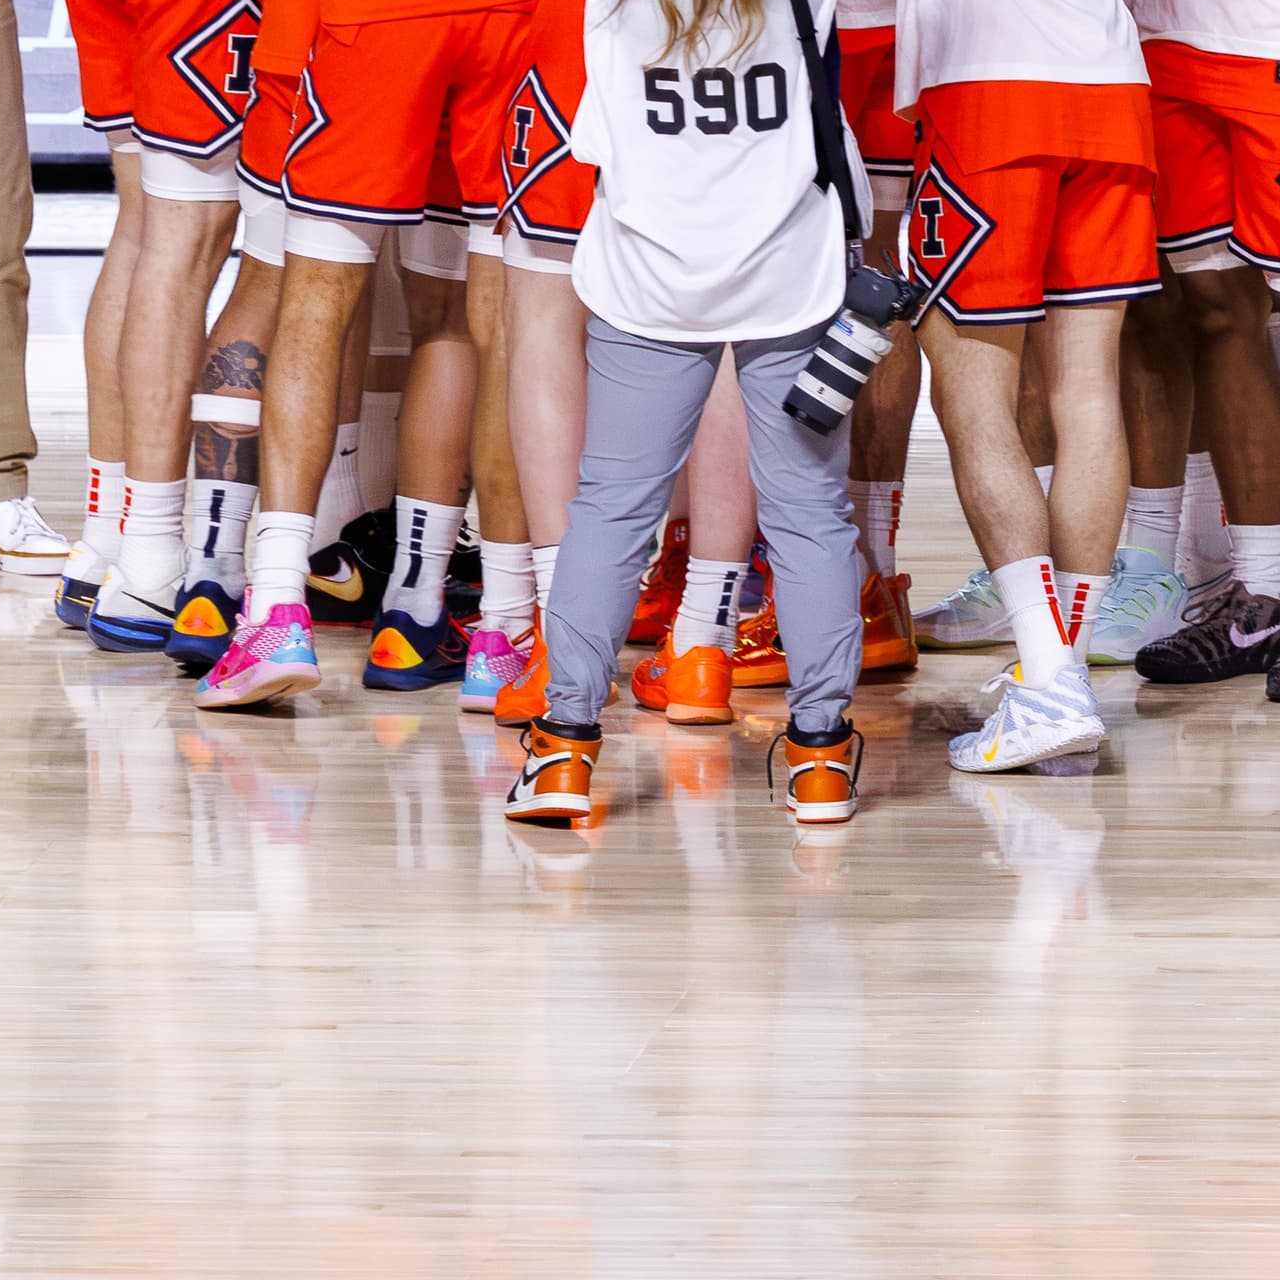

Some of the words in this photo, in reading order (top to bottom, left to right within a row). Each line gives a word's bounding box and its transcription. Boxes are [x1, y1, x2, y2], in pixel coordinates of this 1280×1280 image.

[643, 62, 788, 136] 590
[510, 105, 535, 168] I
[918, 197, 946, 258] I
